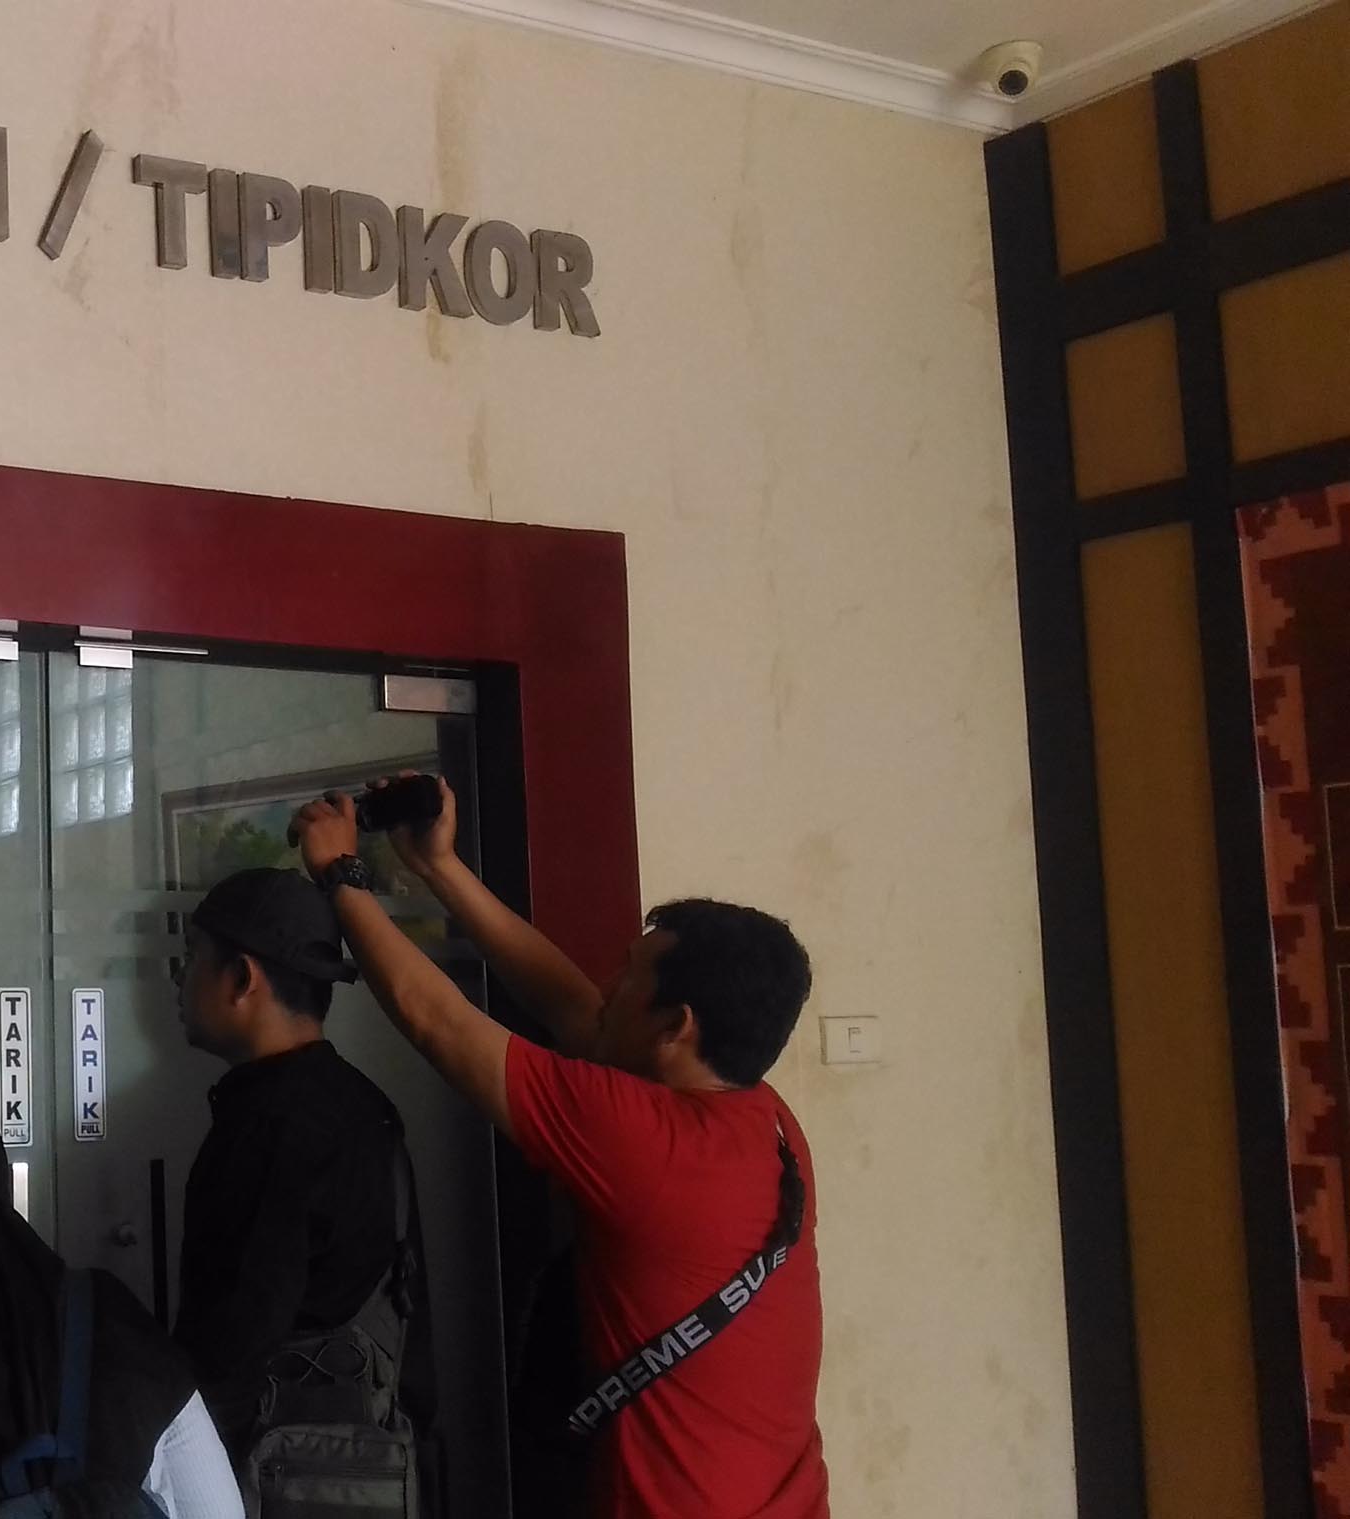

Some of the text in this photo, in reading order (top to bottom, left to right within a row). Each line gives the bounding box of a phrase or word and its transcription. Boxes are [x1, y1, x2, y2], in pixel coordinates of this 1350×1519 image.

[37, 128, 105, 261] /
[131, 153, 602, 338] TIPIDKOR
[4, 996, 23, 1121] TARIK
[81, 998, 100, 1120] TARIK
[3, 1128, 27, 1138] PULL
[80, 1123, 101, 1135] PULL
